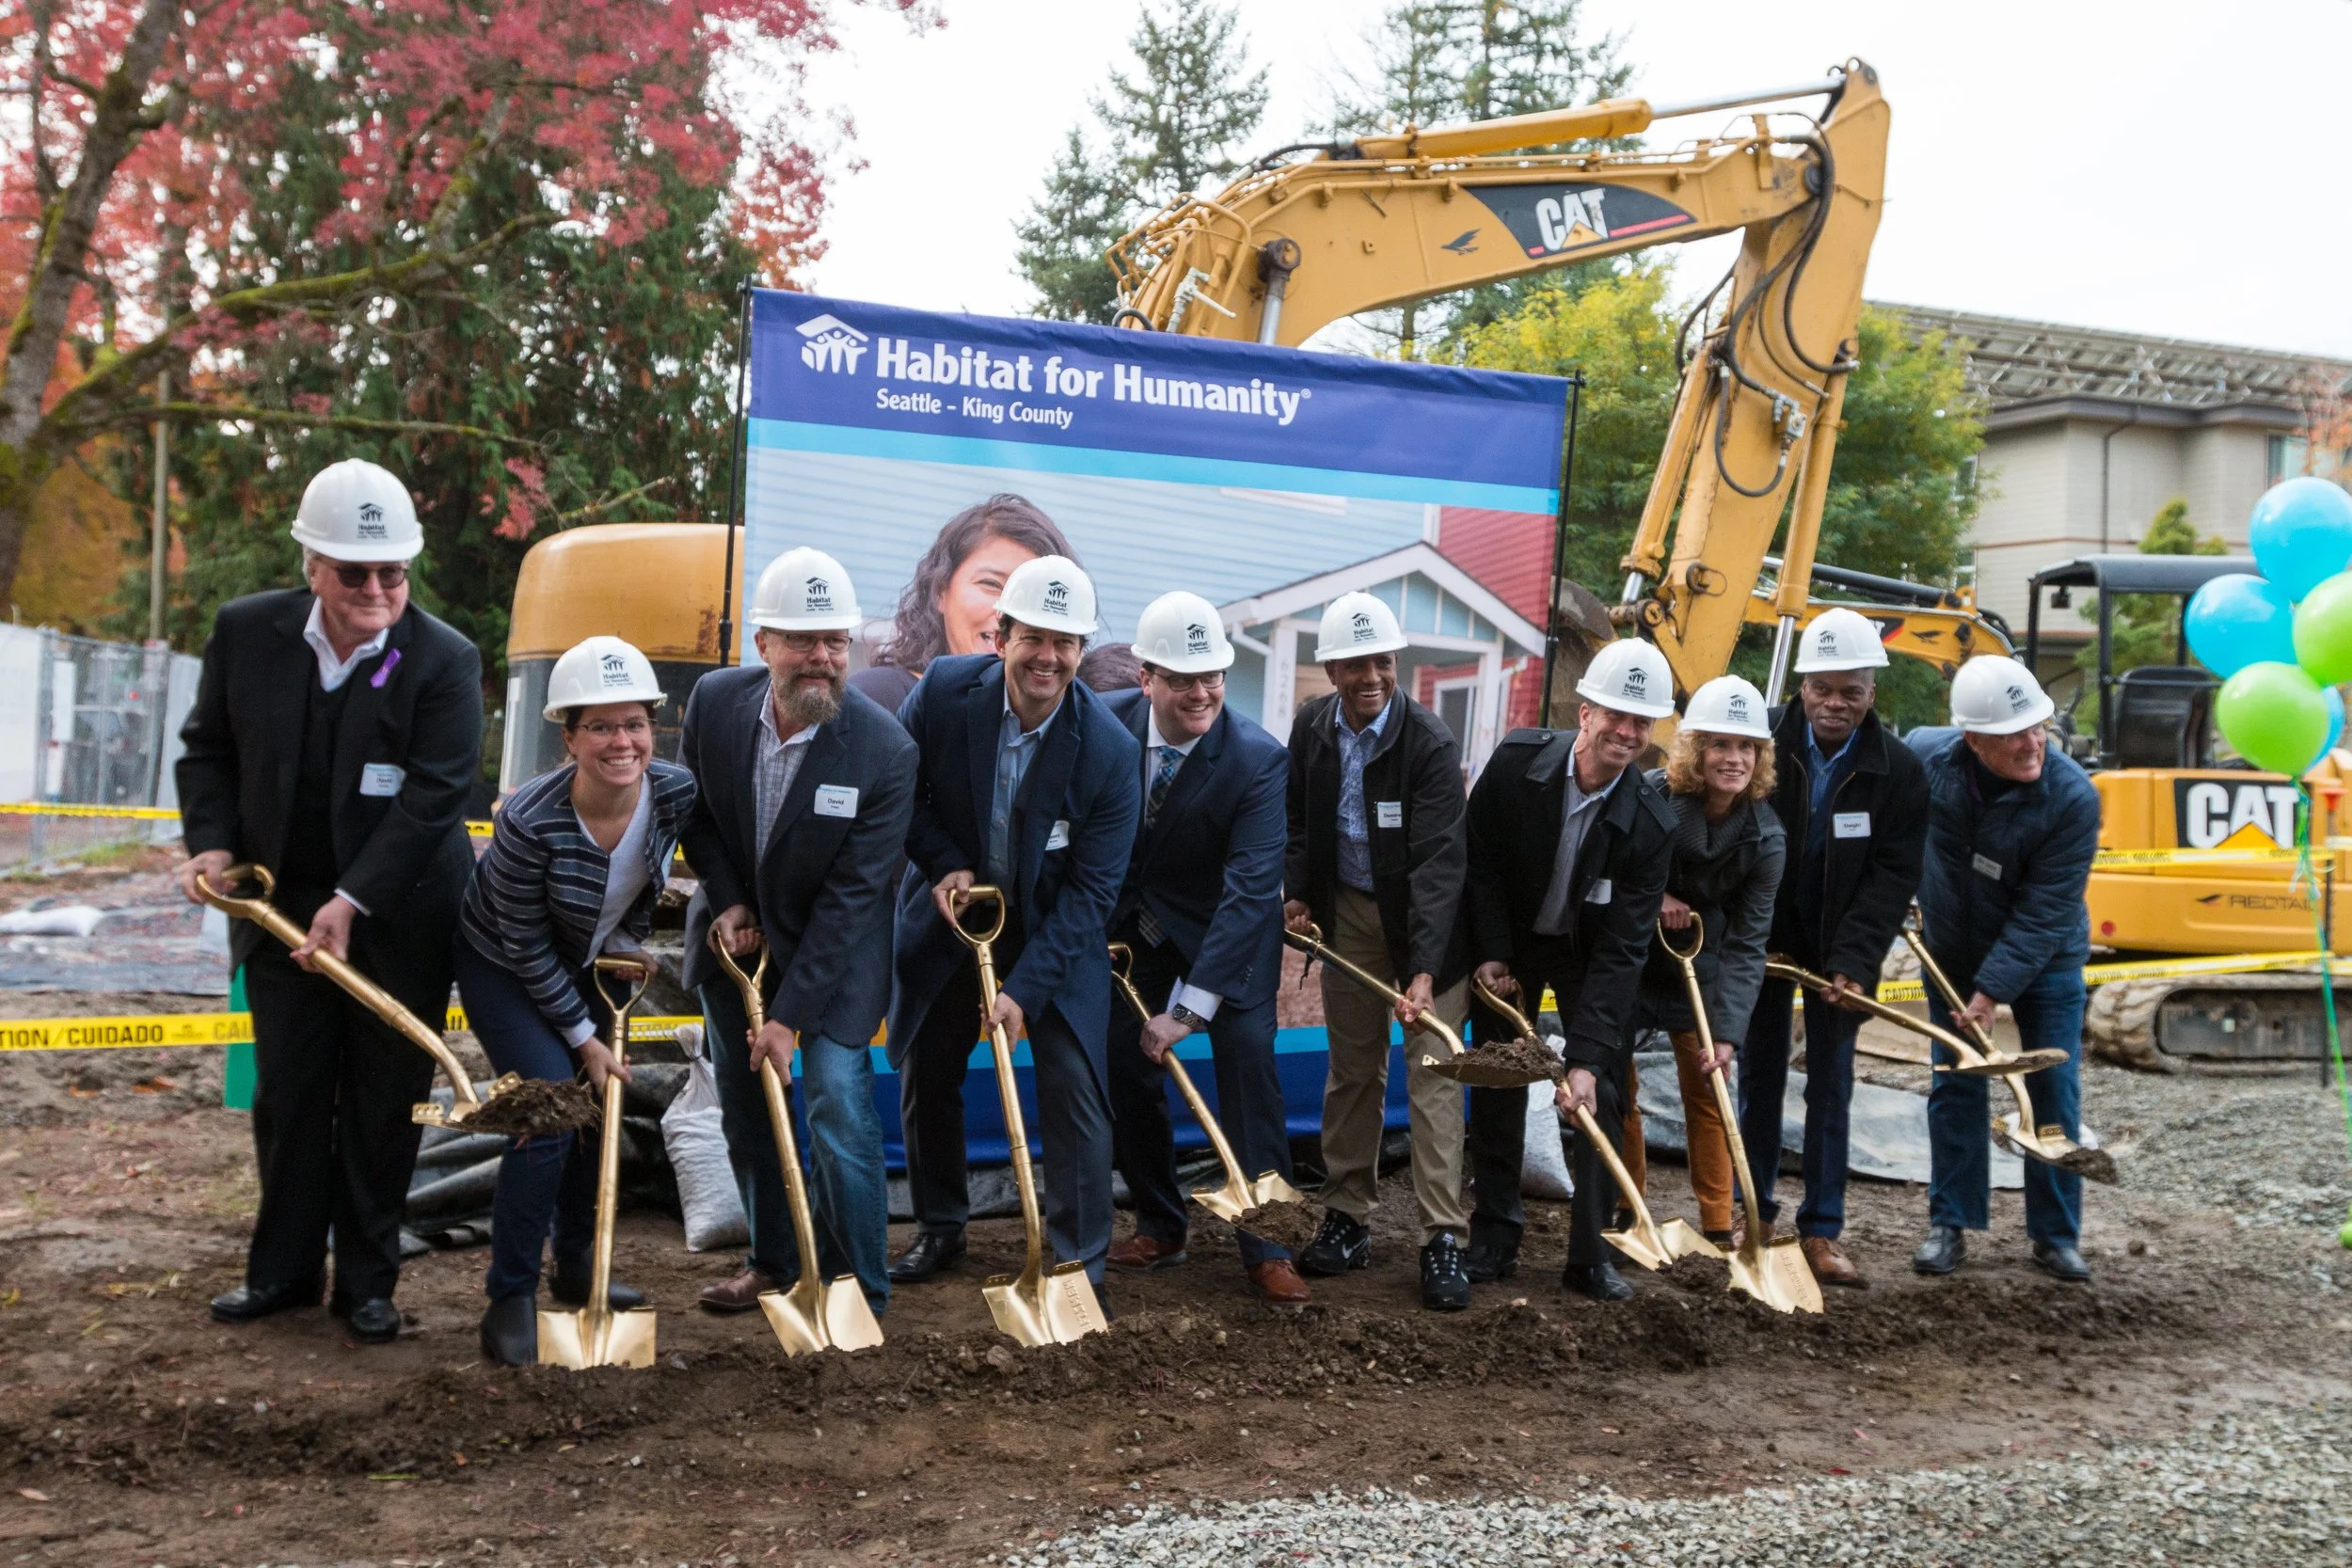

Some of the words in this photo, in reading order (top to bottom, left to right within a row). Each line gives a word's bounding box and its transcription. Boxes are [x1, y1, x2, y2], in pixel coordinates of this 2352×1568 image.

[1535, 187, 1609, 251] CAT
[876, 337, 1034, 393] Habitat
[1043, 356, 1104, 399] for
[876, 388, 942, 415] Seattle
[962, 396, 1004, 424] King
[1009, 402, 1074, 430] County
[1044, 597, 1068, 609] Habitat
[1353, 627, 1375, 636] Habitat
[1624, 683, 1646, 693] Habitat
[2185, 782, 2300, 849] CAT
